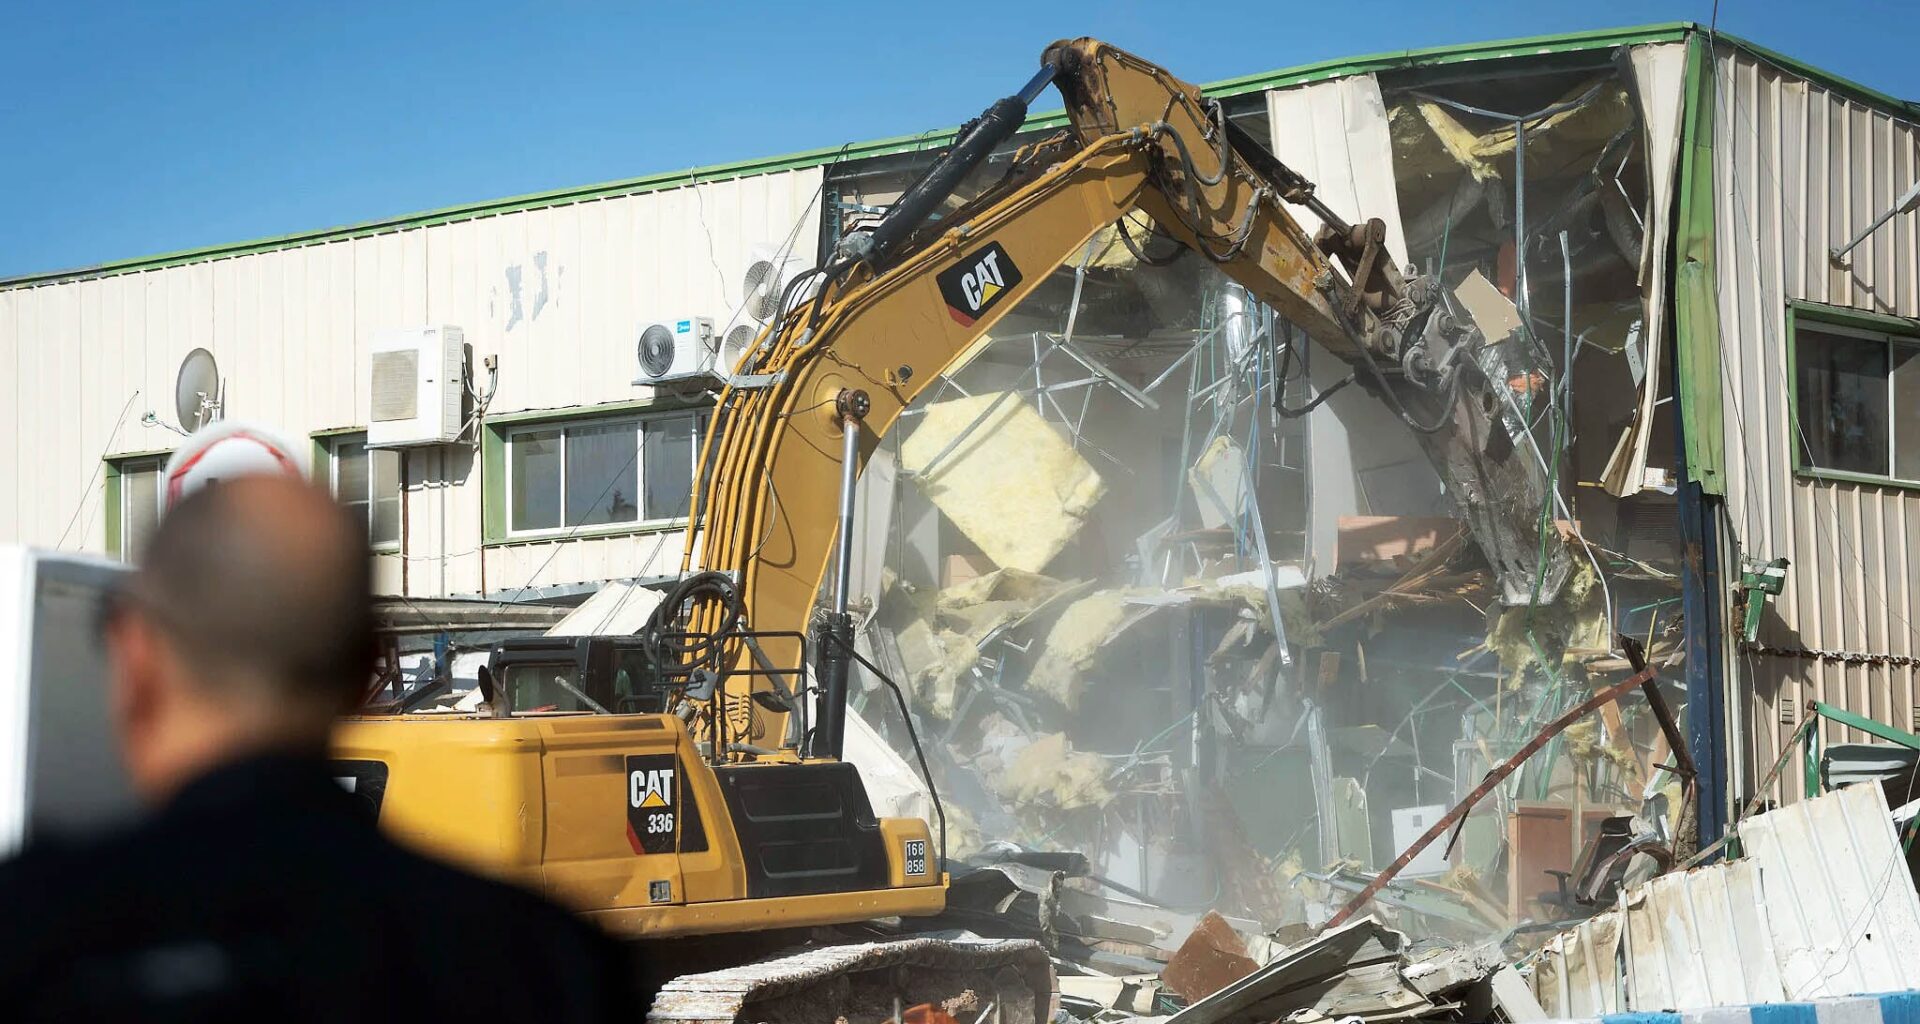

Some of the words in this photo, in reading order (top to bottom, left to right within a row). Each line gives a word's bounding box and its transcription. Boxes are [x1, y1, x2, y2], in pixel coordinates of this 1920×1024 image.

[961, 250, 1004, 311] CAT
[630, 769, 674, 808] CAT
[648, 813, 674, 834] 336
[907, 843, 924, 856] 168
[907, 859, 924, 873] 858
